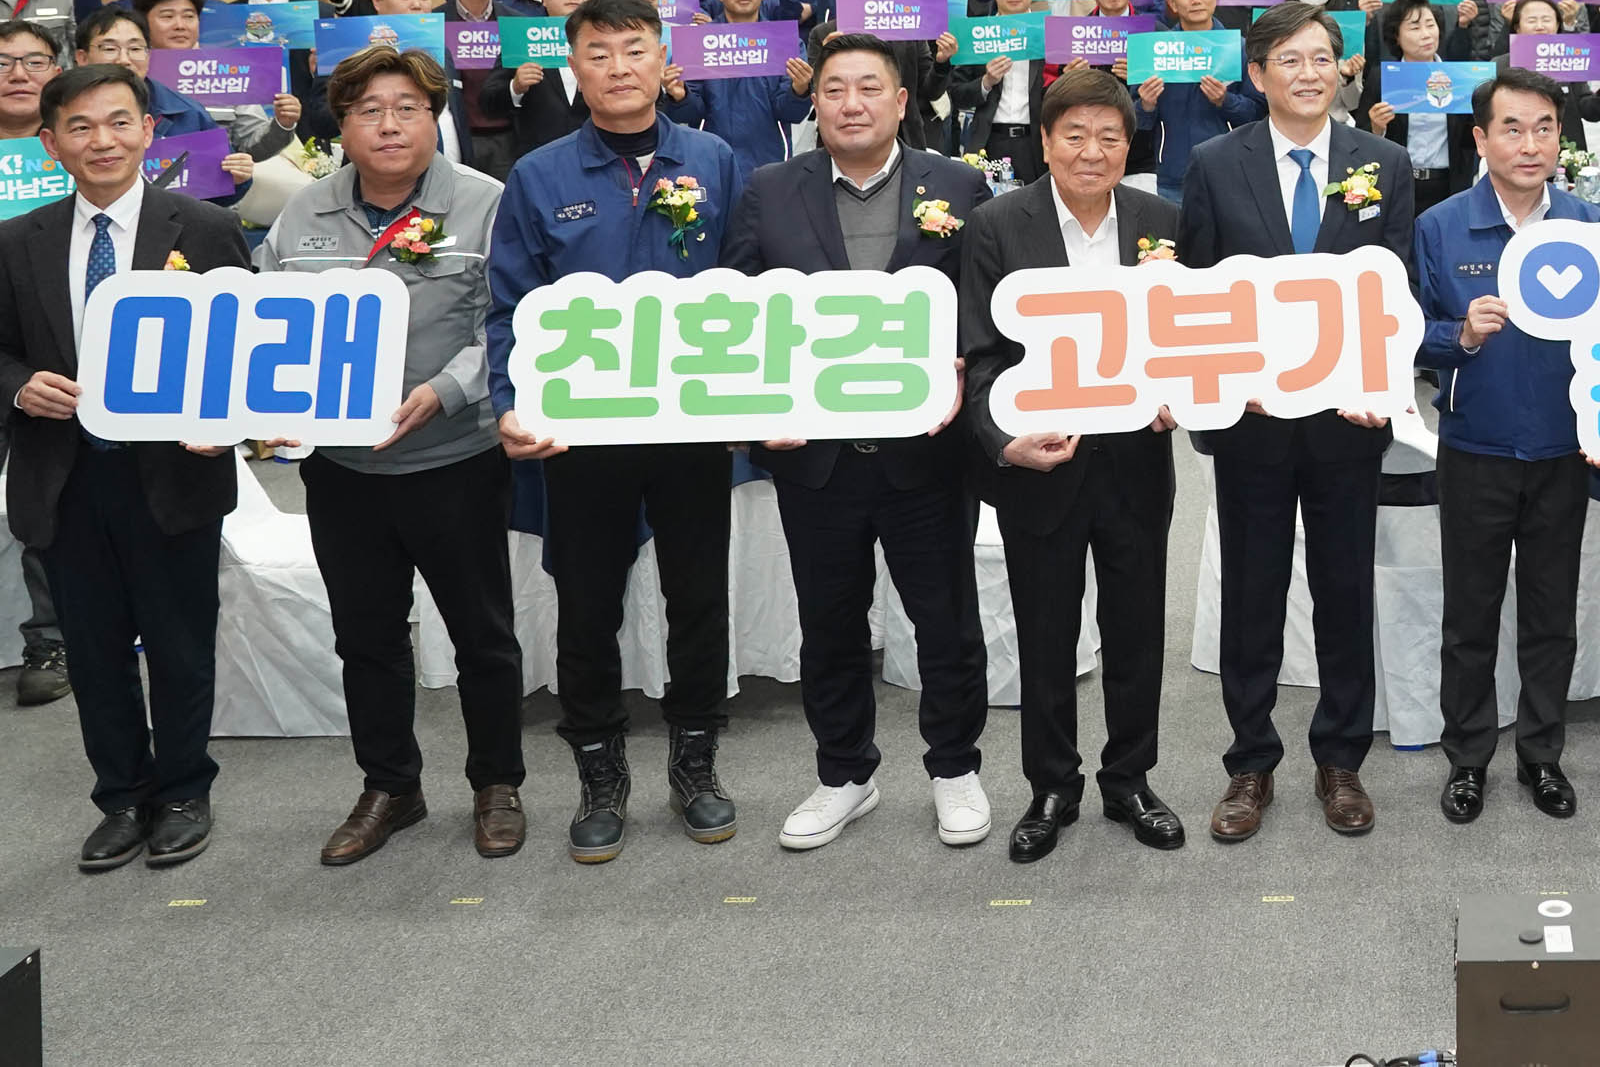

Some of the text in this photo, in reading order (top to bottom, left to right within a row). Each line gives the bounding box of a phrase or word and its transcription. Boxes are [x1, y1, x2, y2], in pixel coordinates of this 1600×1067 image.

[864, 0, 920, 15] OK! Now
[864, 15, 921, 31] 조선산업!
[458, 30, 489, 44] OK!
[526, 26, 560, 41] OK!
[971, 25, 1001, 39] OK!
[1071, 25, 1129, 39] OK! Now
[702, 34, 767, 50] OK! Now
[972, 37, 1027, 54] 전라남도!
[1071, 41, 1129, 55] 조선산업!
[1153, 41, 1185, 55] OK!
[1536, 43, 1590, 57] OK! Now
[703, 49, 768, 67] 조선산업!
[1153, 56, 1213, 71] 전라남도!
[1535, 57, 1590, 72] 조선산업!
[178, 60, 250, 77] OK! Now
[177, 76, 250, 94] 조선산업!
[0, 175, 76, 201] 라남도!
[1014, 269, 1400, 413] 고부가
[103, 291, 382, 421] 미래
[535, 289, 932, 421] 친환경
